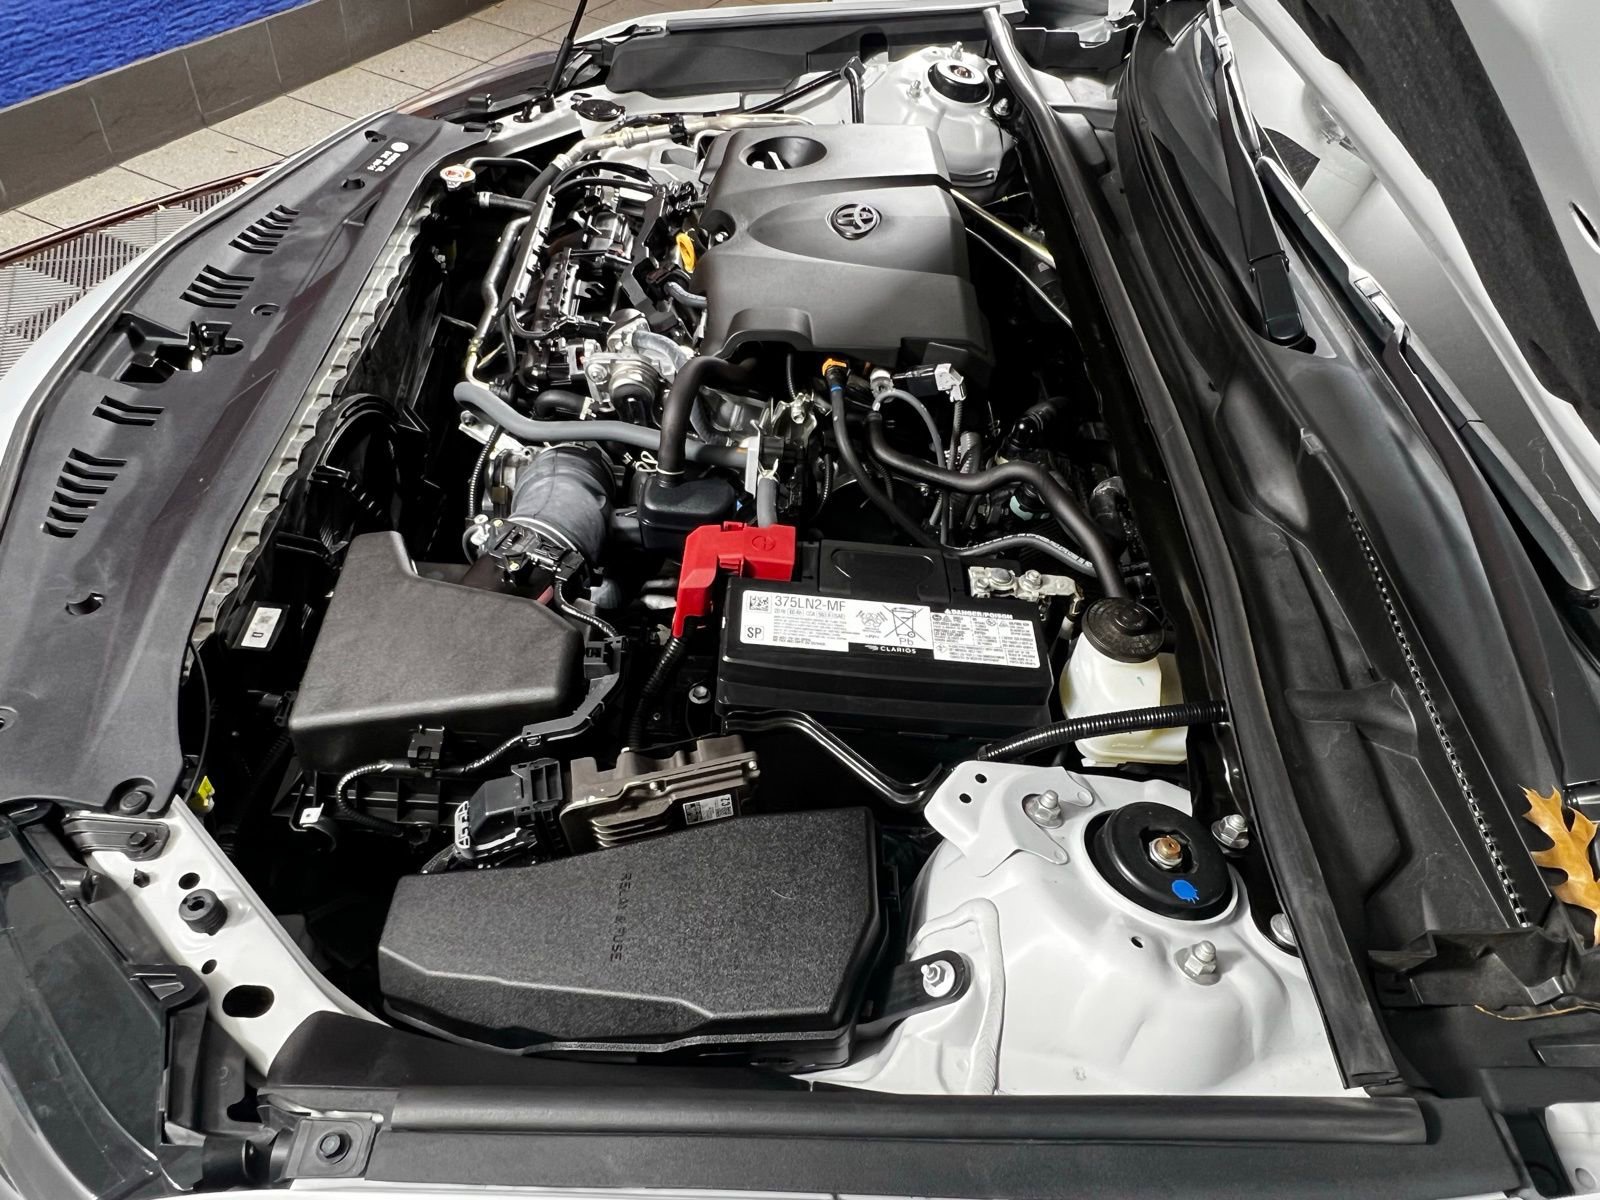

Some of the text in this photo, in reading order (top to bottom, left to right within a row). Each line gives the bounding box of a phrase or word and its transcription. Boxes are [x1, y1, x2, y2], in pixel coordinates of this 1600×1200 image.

[774, 595, 846, 611] 375LN2-MF
[747, 626, 762, 639] SP
[899, 637, 914, 646] Pb
[880, 646, 917, 655] CLARIOS
